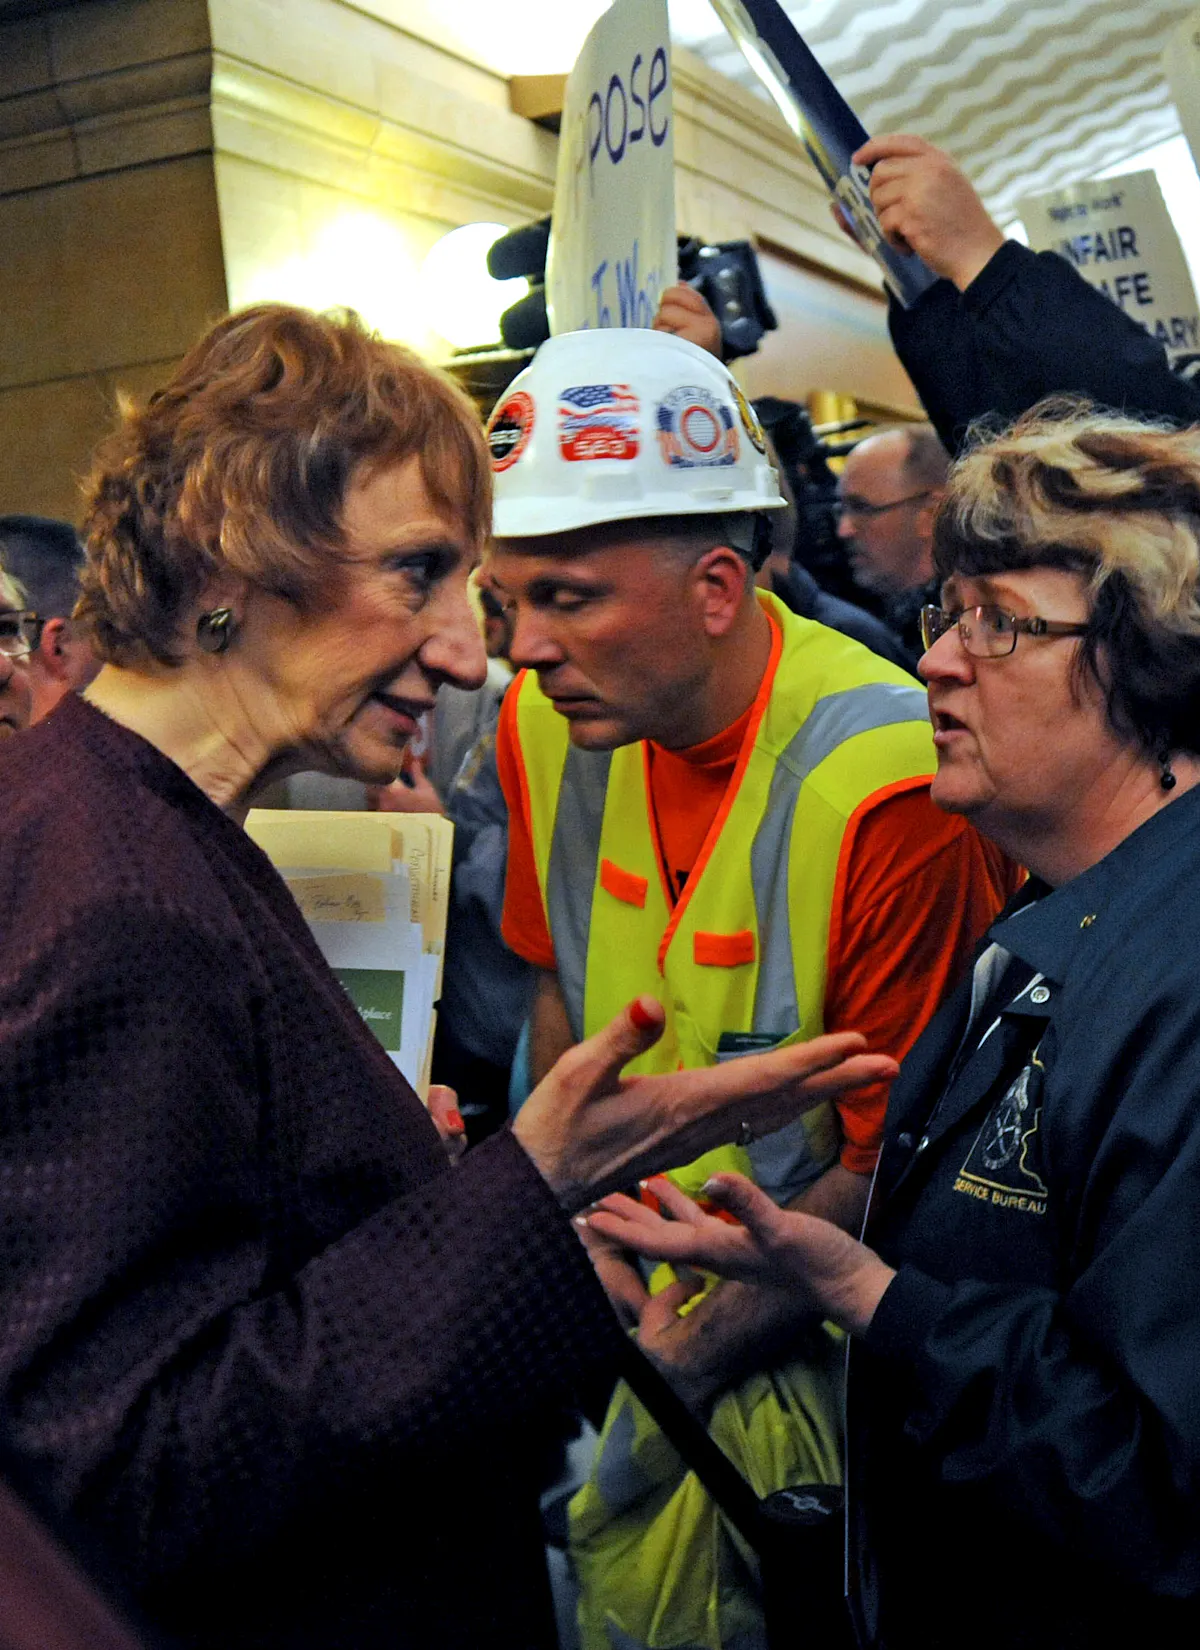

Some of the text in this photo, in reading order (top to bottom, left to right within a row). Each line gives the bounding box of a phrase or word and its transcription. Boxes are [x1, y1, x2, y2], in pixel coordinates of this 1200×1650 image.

[576, 47, 669, 205] pose
[1061, 226, 1139, 265] NFAIR
[1100, 272, 1154, 308] AFE
[952, 1177, 1048, 1215] SERVICE BUREAU
